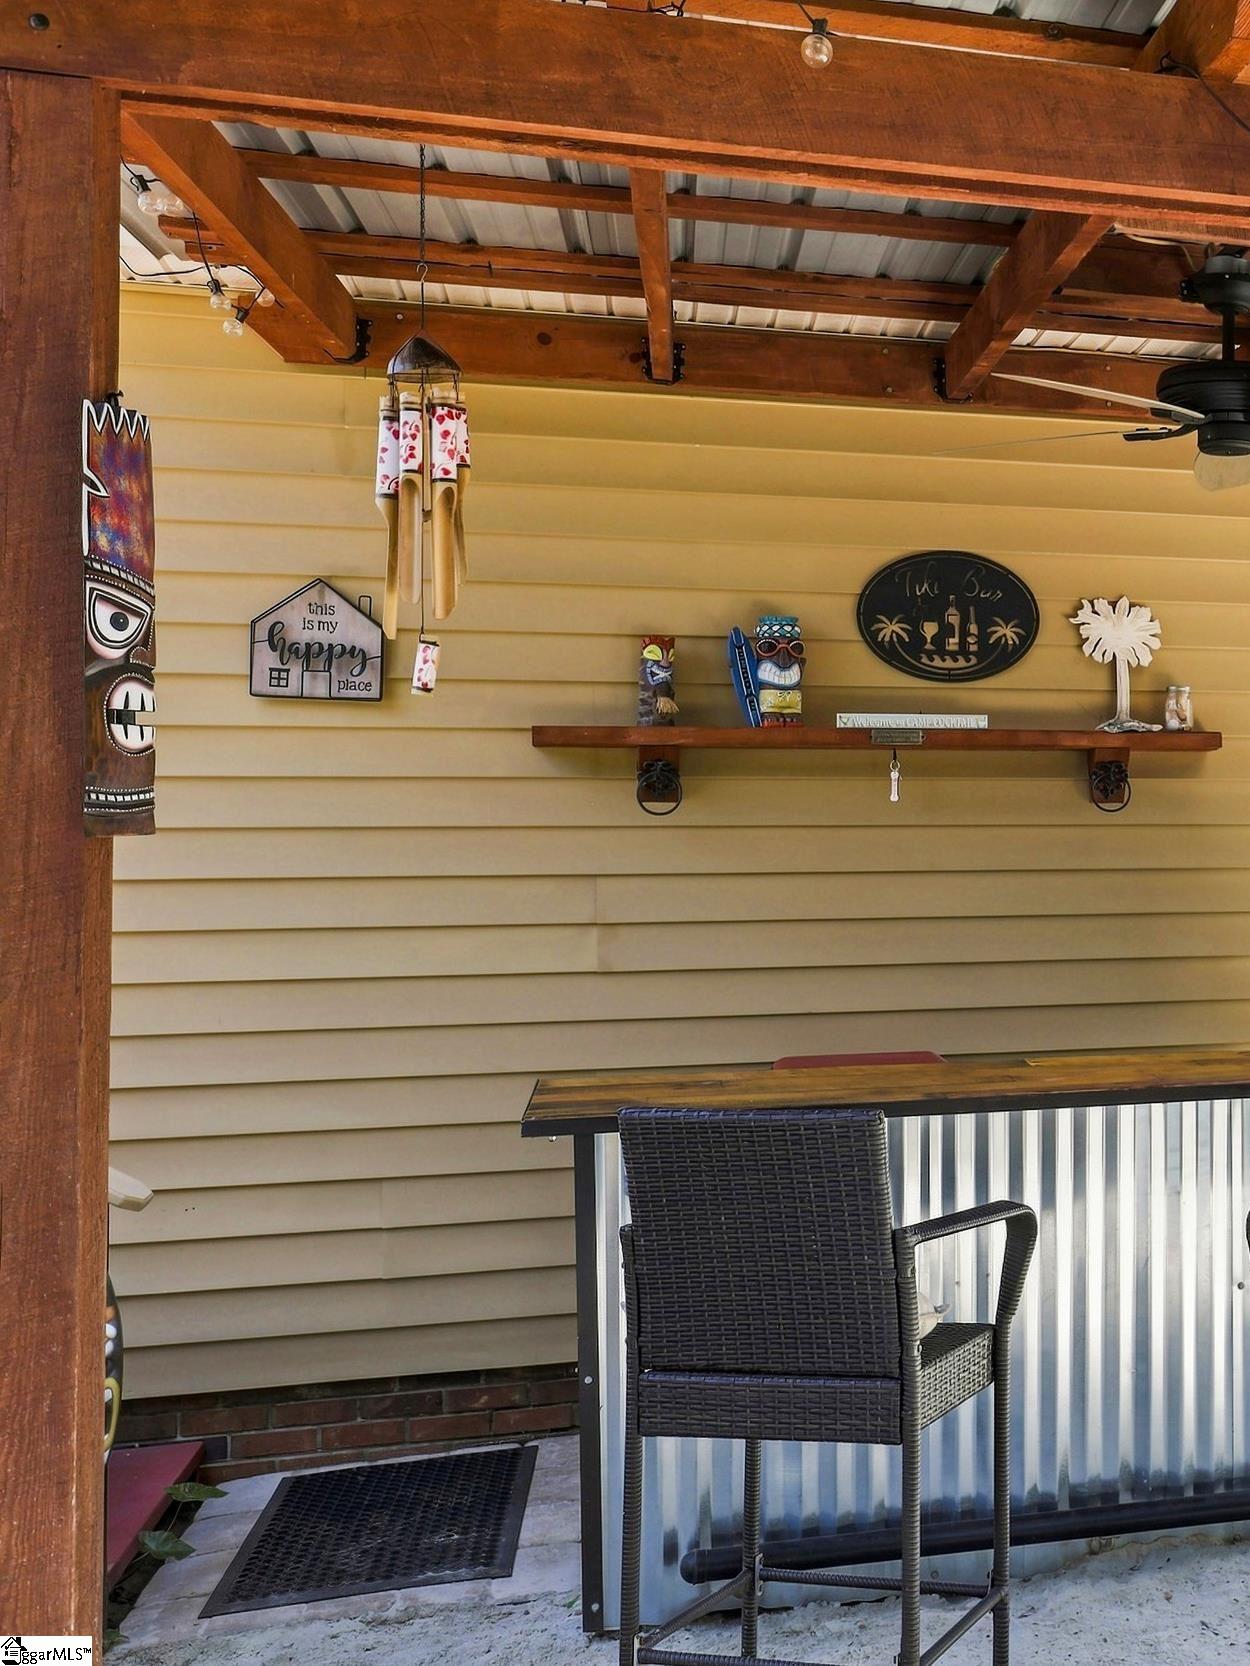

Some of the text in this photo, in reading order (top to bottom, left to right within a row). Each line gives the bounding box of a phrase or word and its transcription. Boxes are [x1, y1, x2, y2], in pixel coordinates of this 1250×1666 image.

[308, 602, 336, 616] this
[302, 617, 339, 634] is my
[268, 621, 368, 677] happy
[337, 678, 373, 693] place
